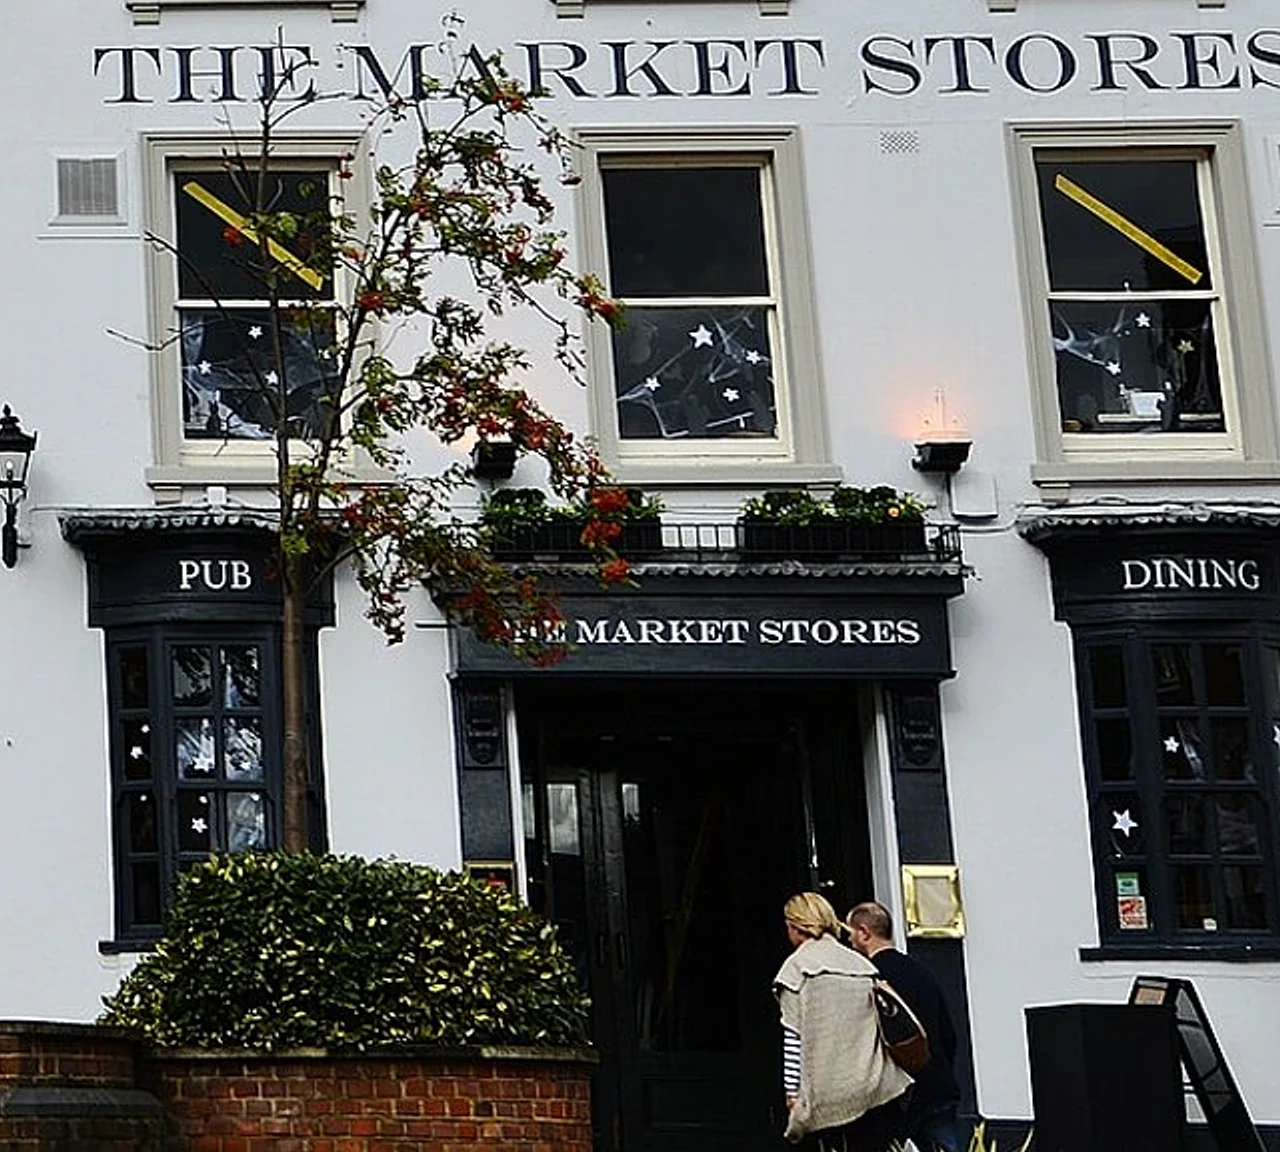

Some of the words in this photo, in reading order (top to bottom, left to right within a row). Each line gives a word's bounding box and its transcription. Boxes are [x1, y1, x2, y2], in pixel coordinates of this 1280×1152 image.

[92, 44, 312, 103] THE
[342, 39, 827, 102] MARKET
[860, 31, 1280, 95] STORES
[178, 559, 252, 590] PUB
[1121, 557, 1260, 590] DINING
[575, 619, 750, 645] MARKET
[758, 619, 922, 645] STORES
